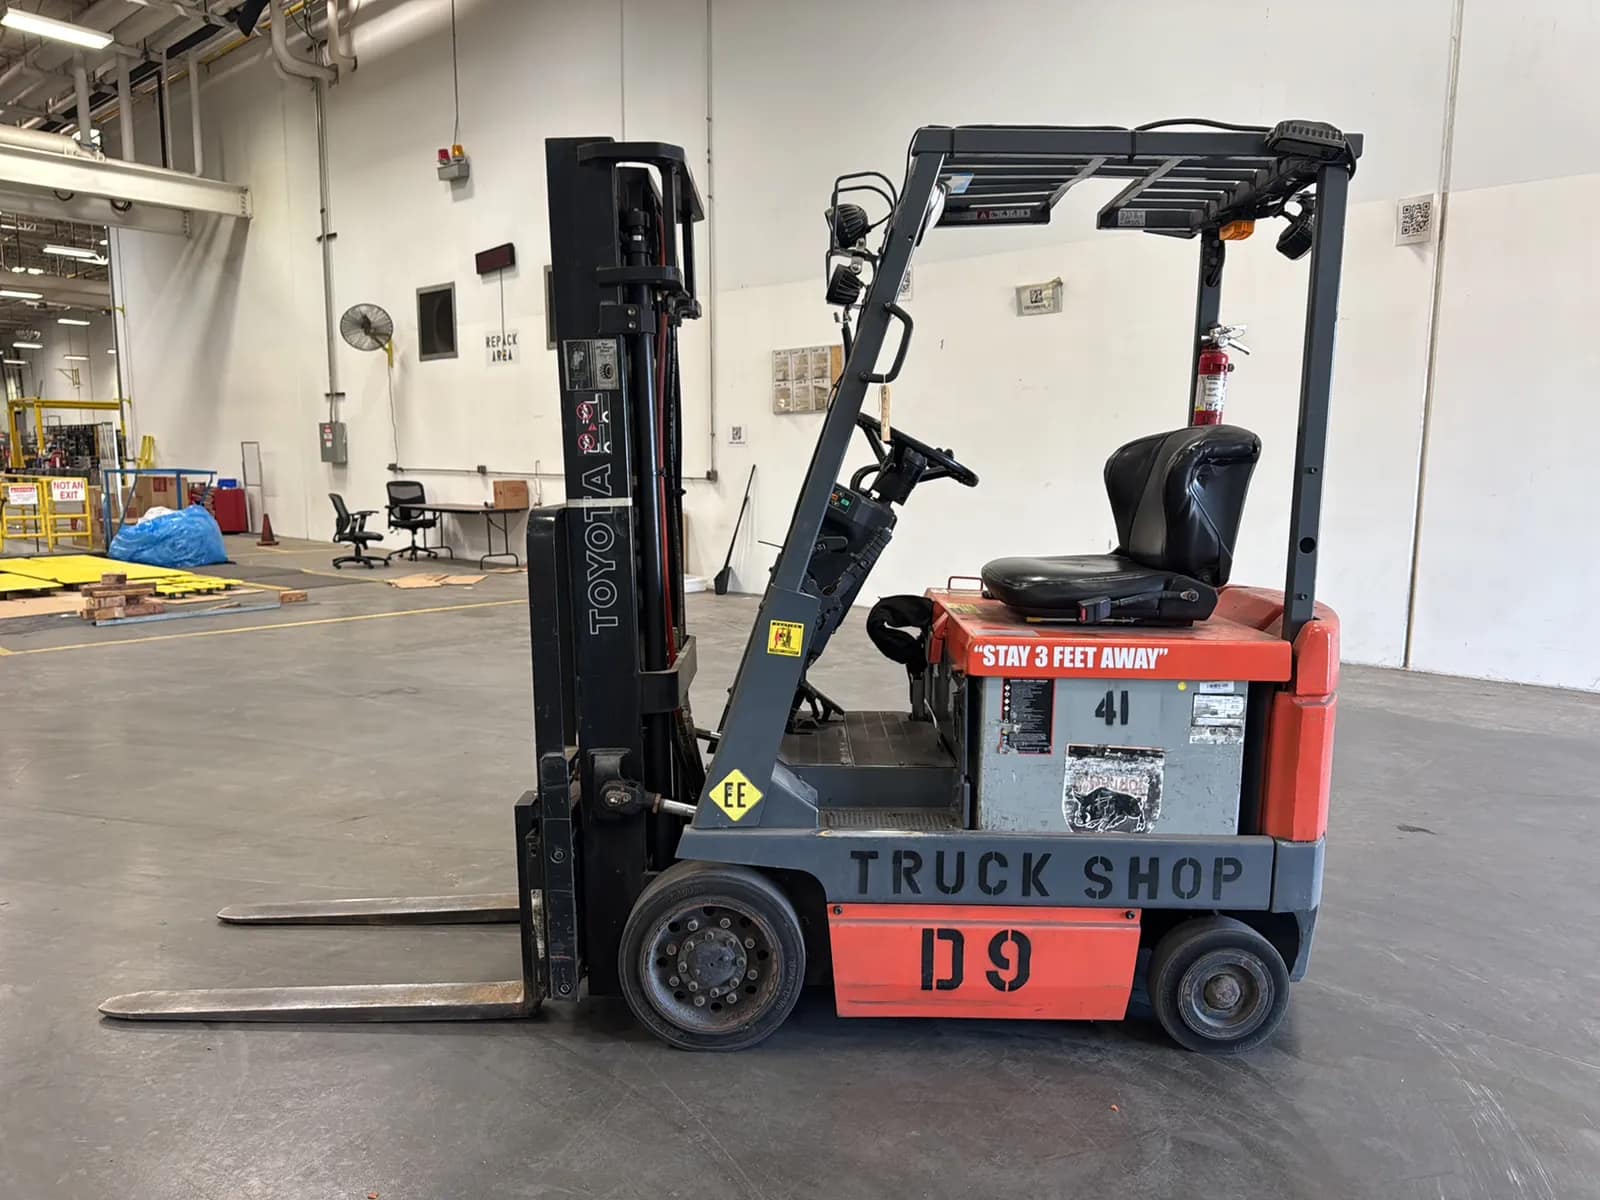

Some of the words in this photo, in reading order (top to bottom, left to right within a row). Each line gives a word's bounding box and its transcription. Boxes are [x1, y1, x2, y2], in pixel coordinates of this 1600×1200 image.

[485, 333, 518, 348] REPACK
[492, 349, 513, 362] AREA
[53, 481, 71, 490] NOT
[71, 481, 84, 490] AN
[60, 490, 79, 500] EXIT
[582, 463, 619, 636] TOYOTA
[1034, 645, 1049, 668] 3
[1053, 646, 1097, 669] FEET
[1094, 690, 1129, 726] 41
[723, 782, 747, 808] EE
[849, 850, 1053, 897] TRUCK
[1083, 855, 1243, 900] SHOP
